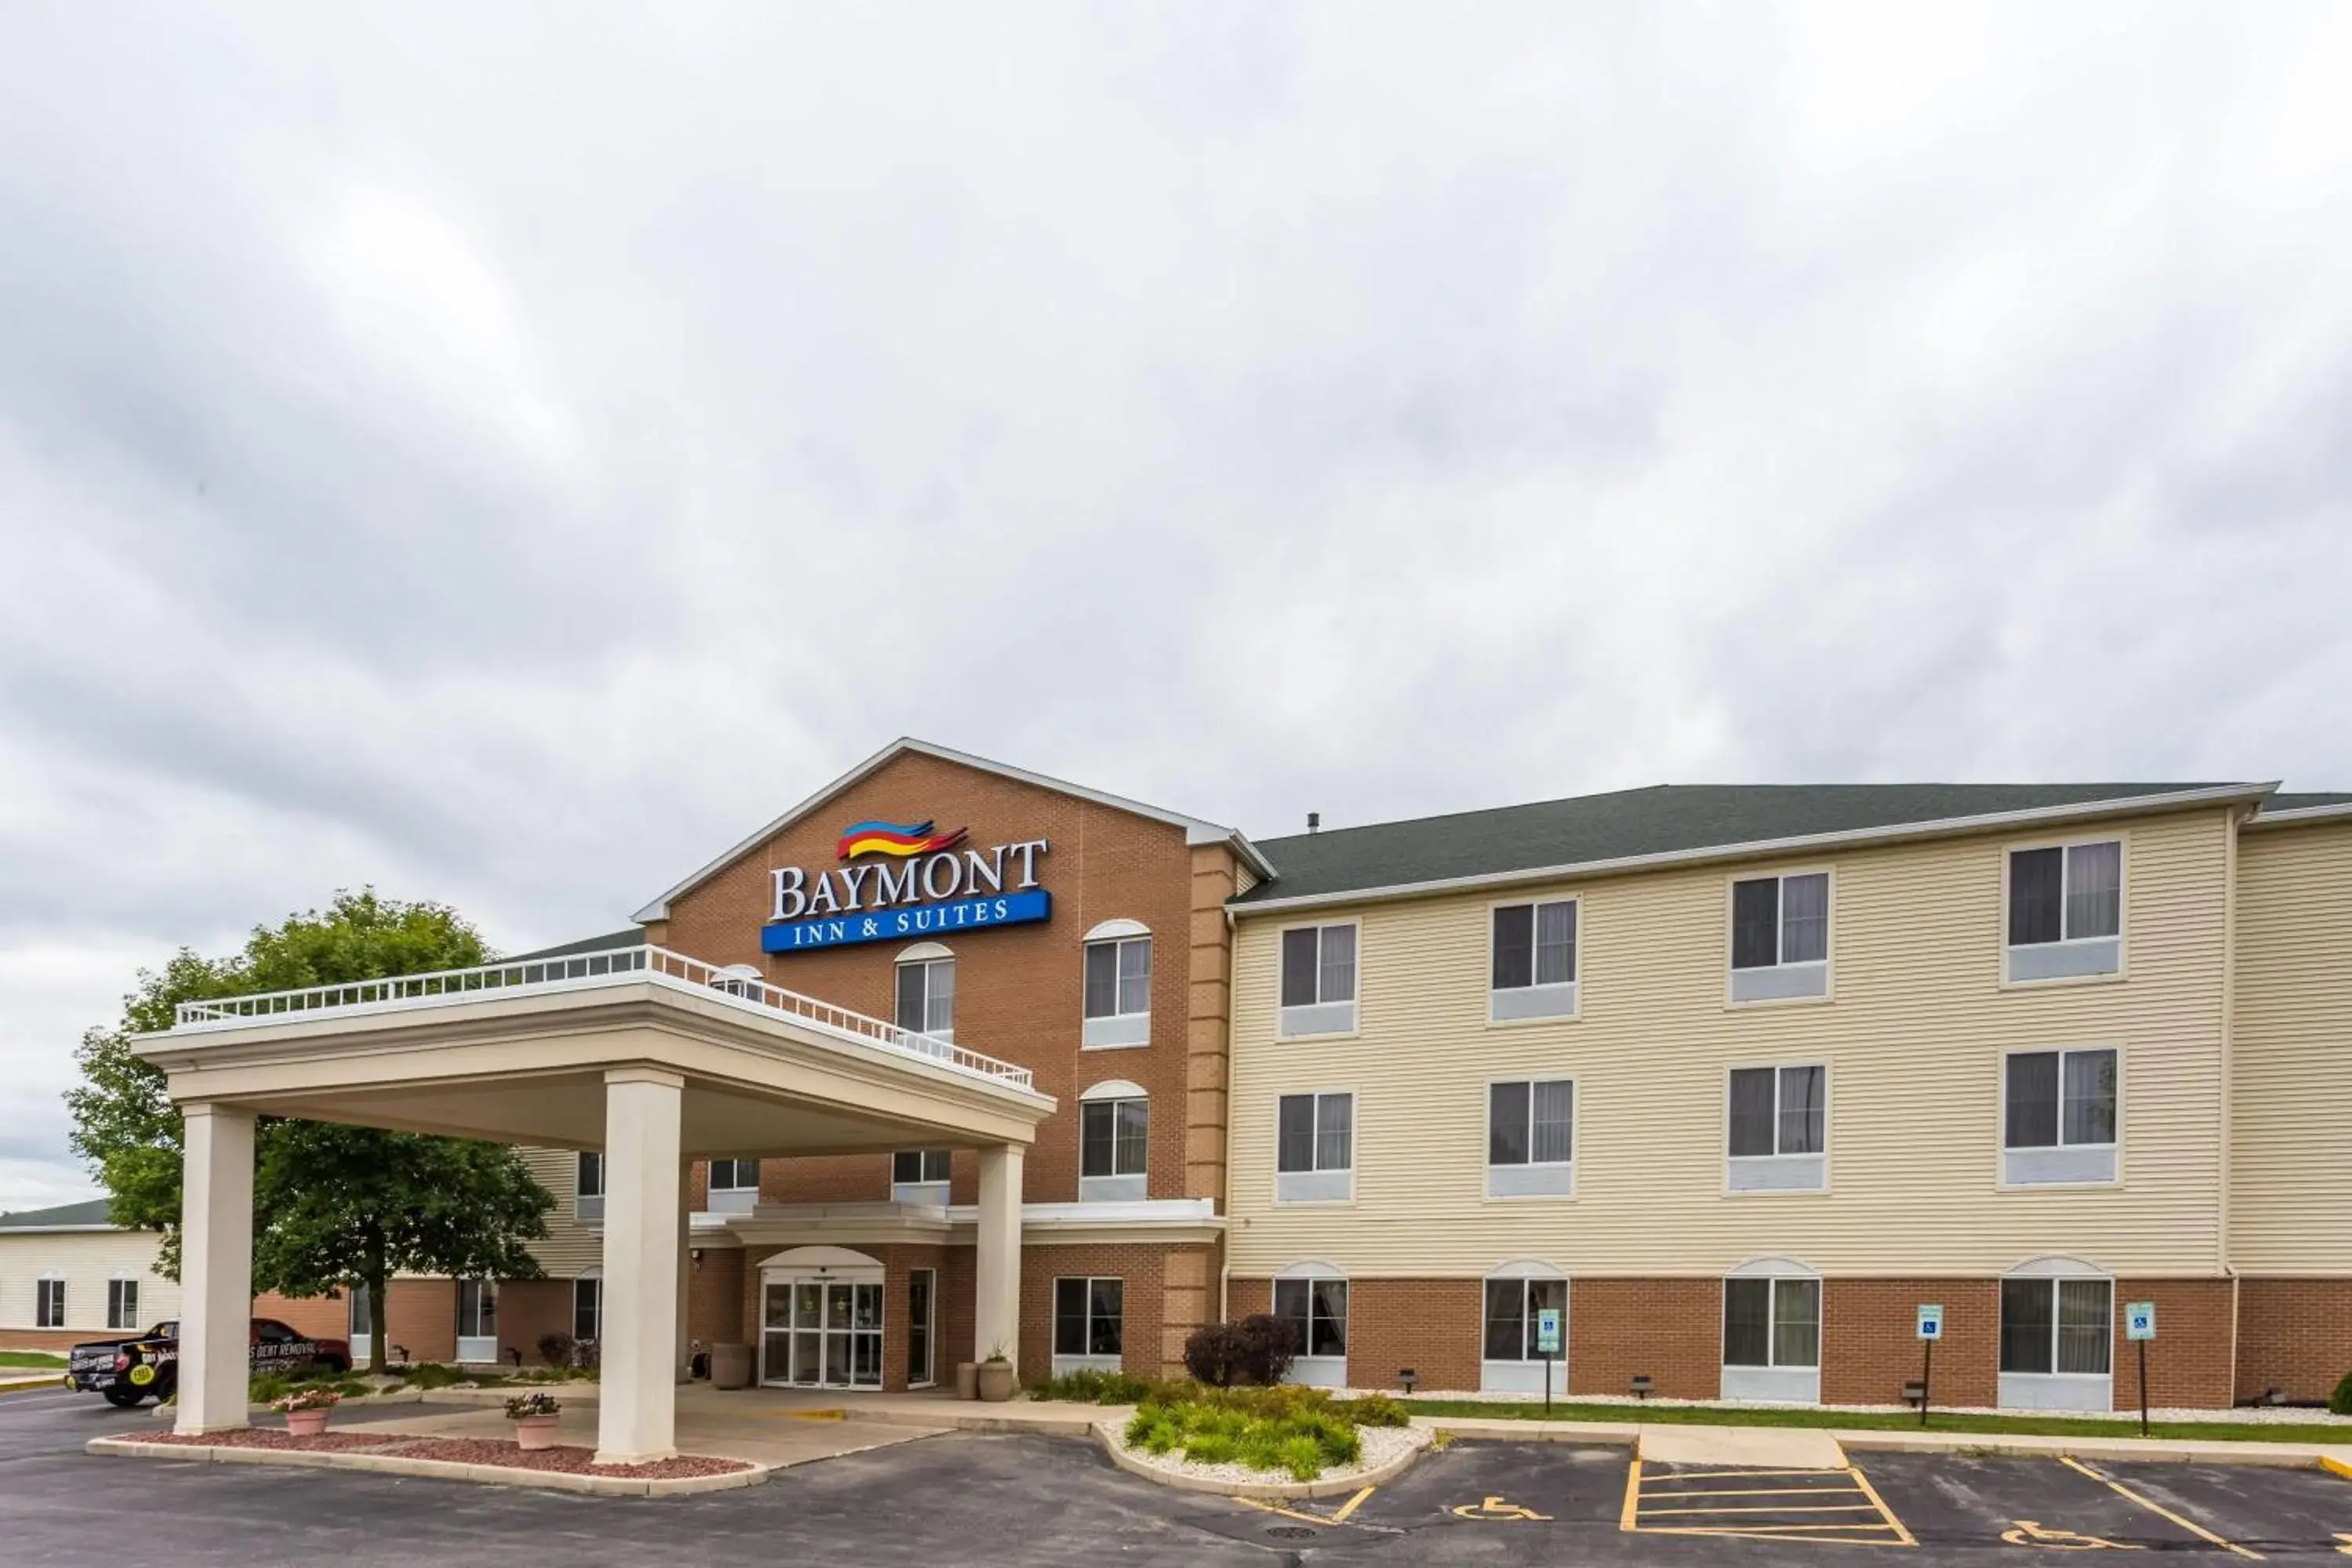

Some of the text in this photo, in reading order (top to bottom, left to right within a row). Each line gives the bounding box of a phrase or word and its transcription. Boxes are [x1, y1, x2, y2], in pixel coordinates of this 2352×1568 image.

[770, 838, 1048, 921] BAYMONT
[793, 899, 1008, 945] INN & SUITES
